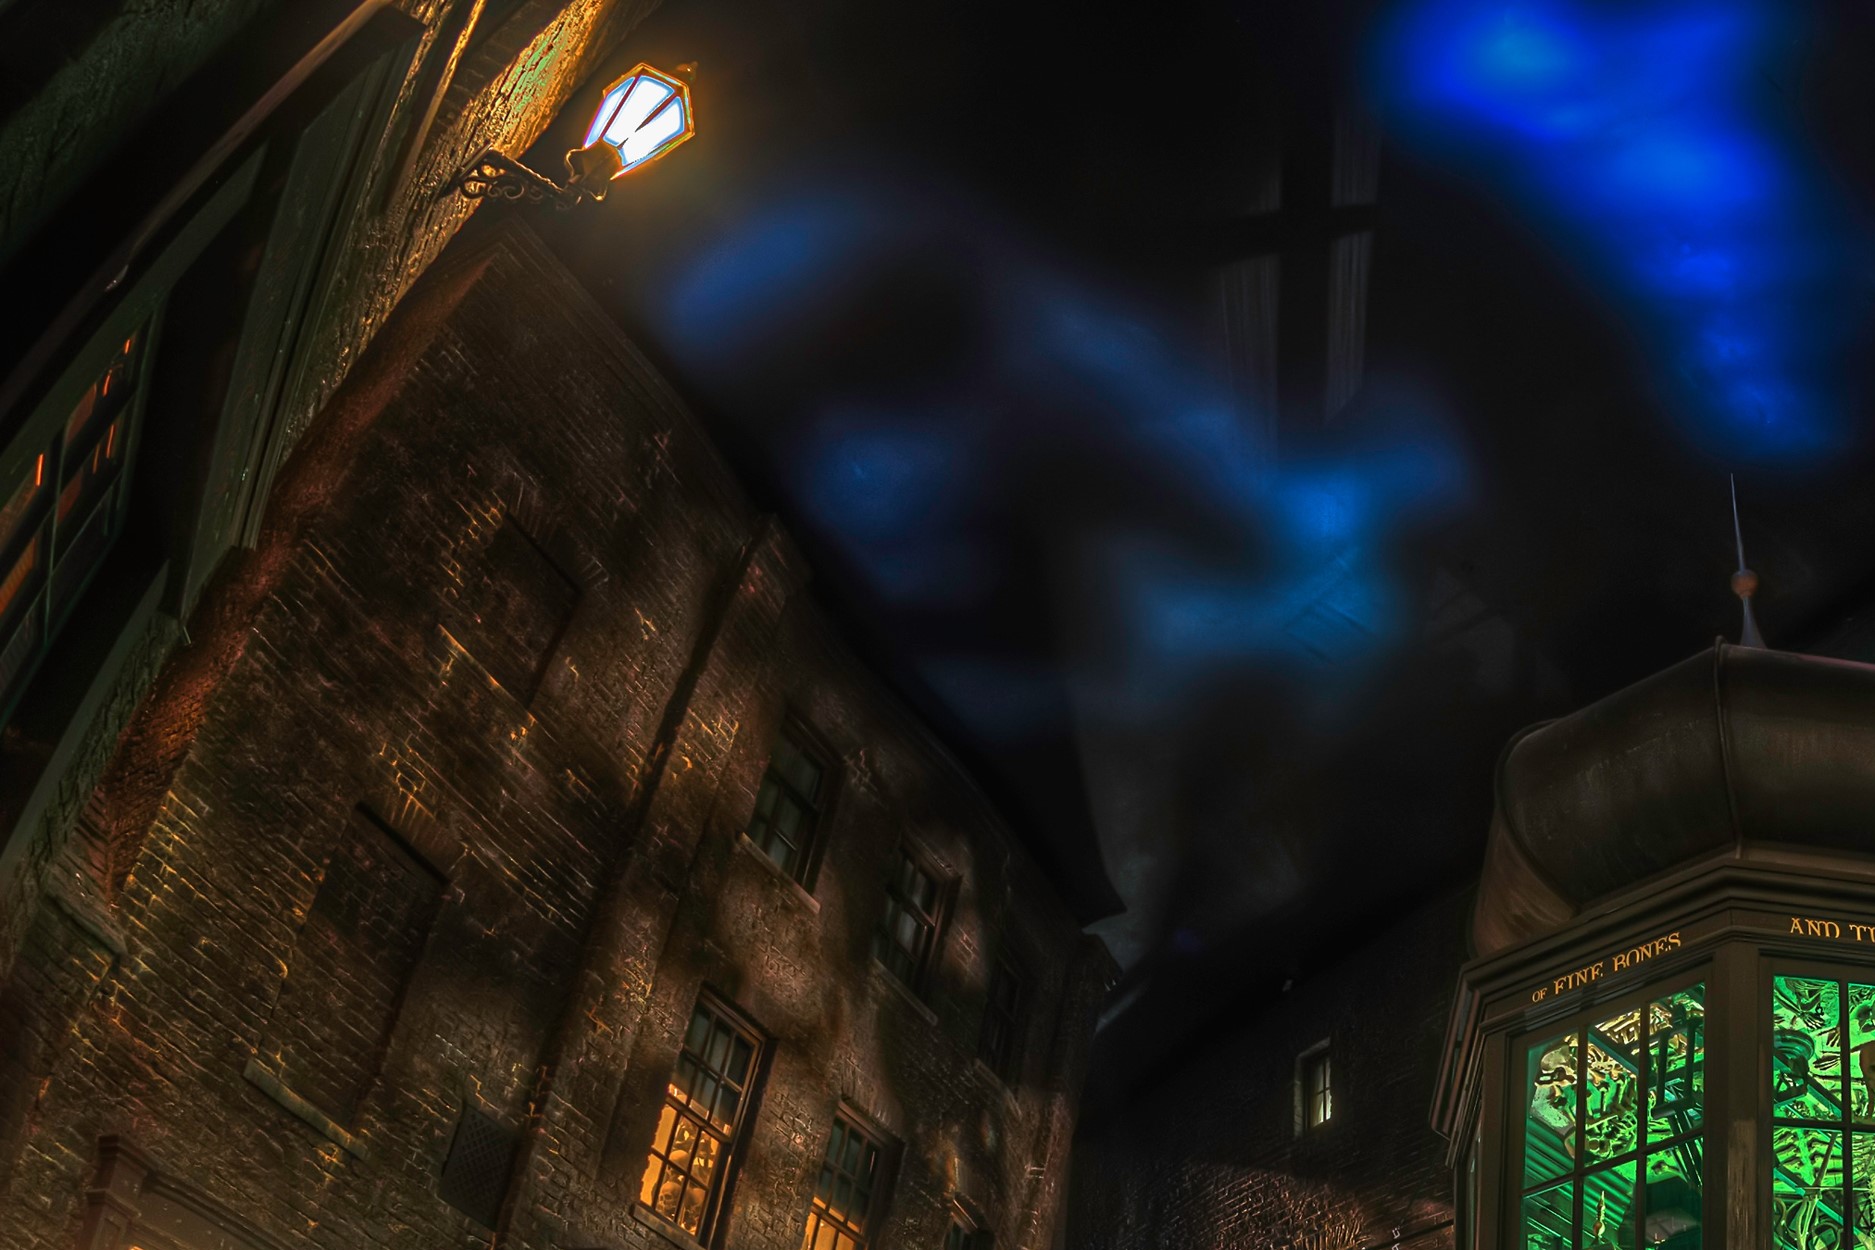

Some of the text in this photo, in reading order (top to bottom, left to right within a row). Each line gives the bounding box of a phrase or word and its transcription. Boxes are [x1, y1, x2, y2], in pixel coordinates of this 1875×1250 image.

[1790, 917, 1841, 939] AND
[1532, 932, 1682, 1003] OF FINE BONES
